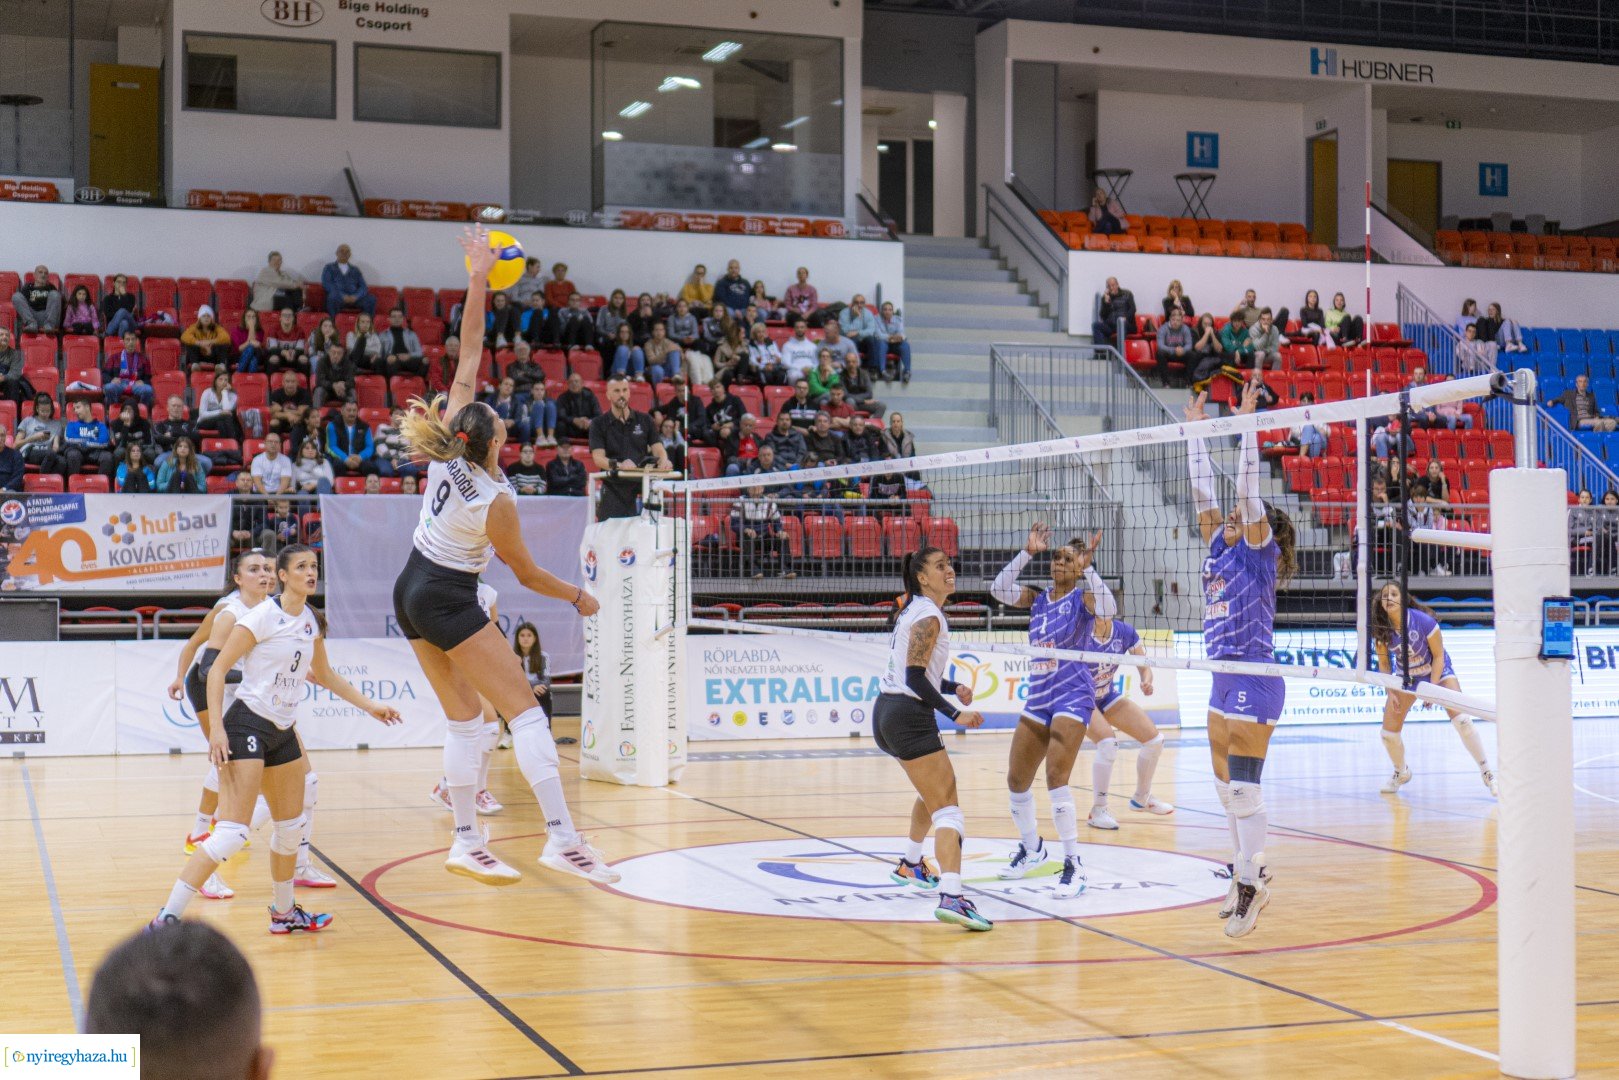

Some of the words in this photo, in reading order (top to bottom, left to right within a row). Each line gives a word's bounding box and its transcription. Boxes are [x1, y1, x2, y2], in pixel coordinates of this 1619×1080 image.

[338, 0, 370, 13] Bige
[374, 1, 430, 18] Holding
[355, 16, 412, 31] Csoport
[1342, 58, 1434, 83] HÜBNER
[446, 458, 480, 503] ARAOĞLU
[431, 479, 451, 517] 9
[140, 510, 217, 535] hufbau
[289, 650, 302, 673] 3
[703, 646, 781, 663] RÖPLABDA
[725, 664, 767, 675] NEMZETI
[769, 662, 824, 675] BAJNOKSÁG
[705, 675, 881, 706] EXTRALIGA
[1237, 691, 1247, 703] 5
[1309, 686, 1347, 698] Orosz
[1351, 685, 1366, 697] és
[13, 733, 42, 743] KFT
[247, 735, 258, 752] 3
